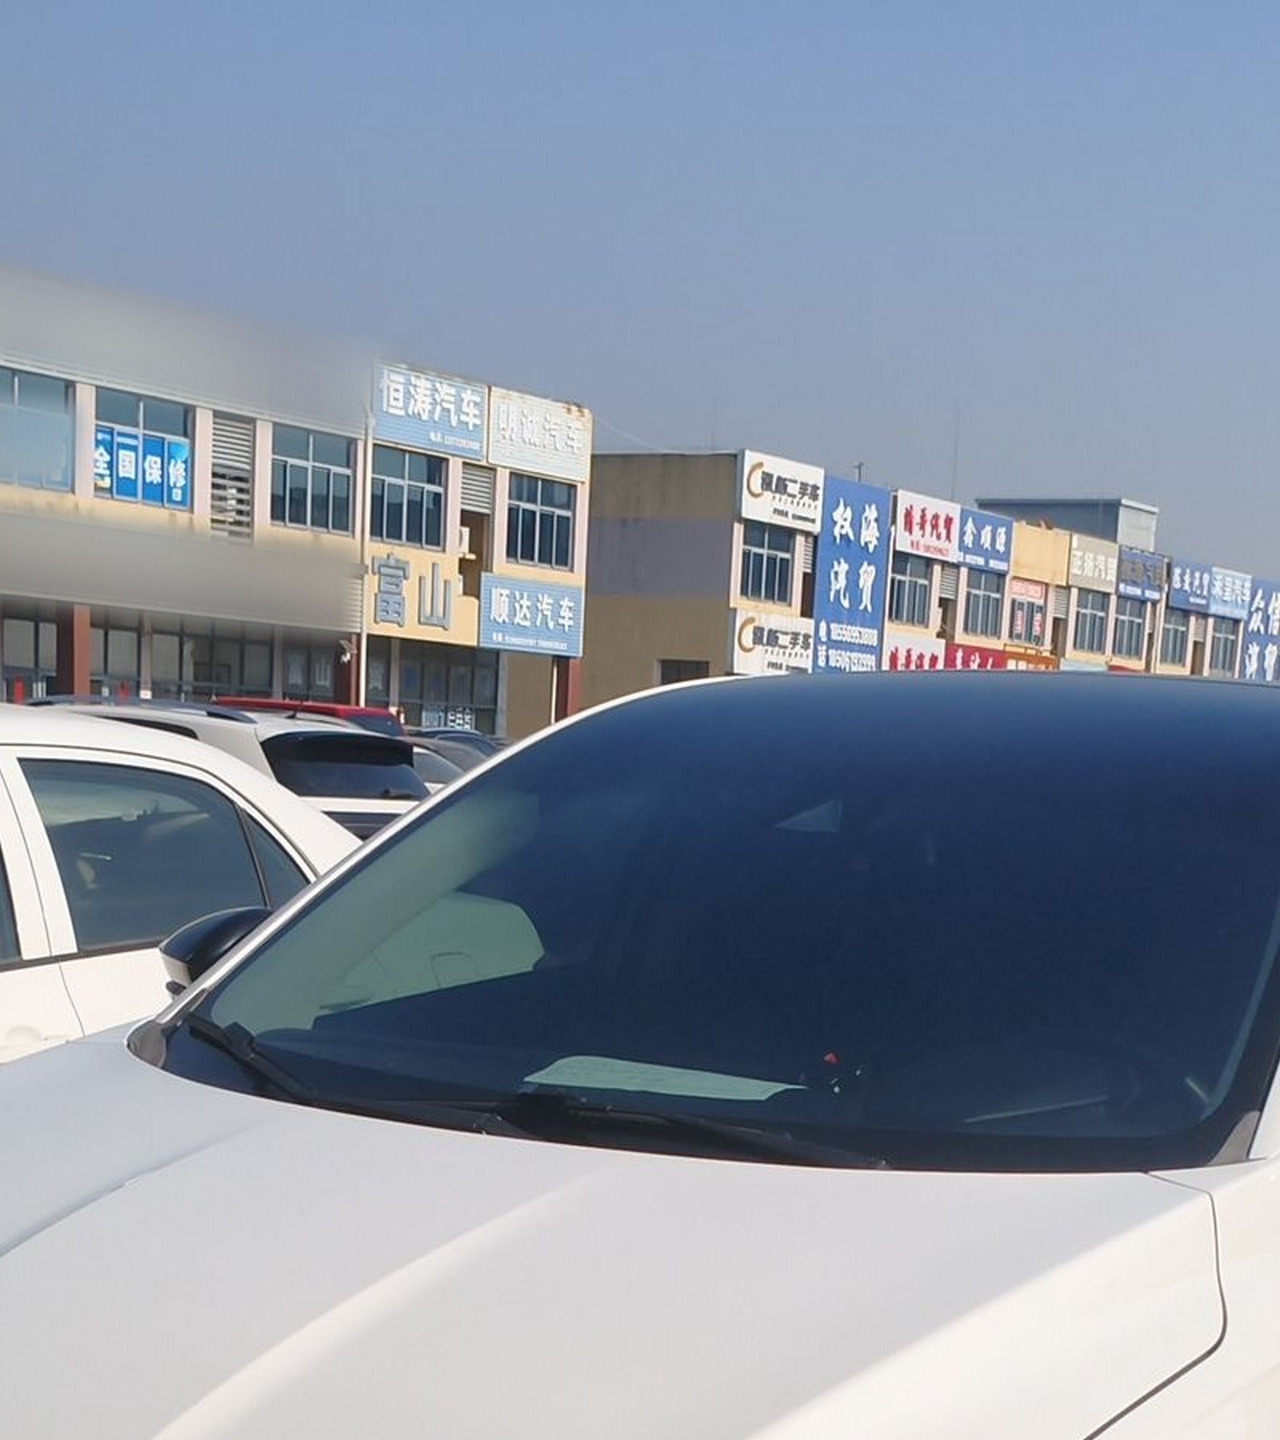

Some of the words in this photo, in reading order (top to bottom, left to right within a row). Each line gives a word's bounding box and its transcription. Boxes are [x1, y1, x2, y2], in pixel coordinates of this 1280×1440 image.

[380, 369, 481, 431] 恒涛汽车
[93, 445, 186, 488] 全国保修
[371, 552, 451, 630] 富山
[490, 588, 574, 632] 顺达汽车
